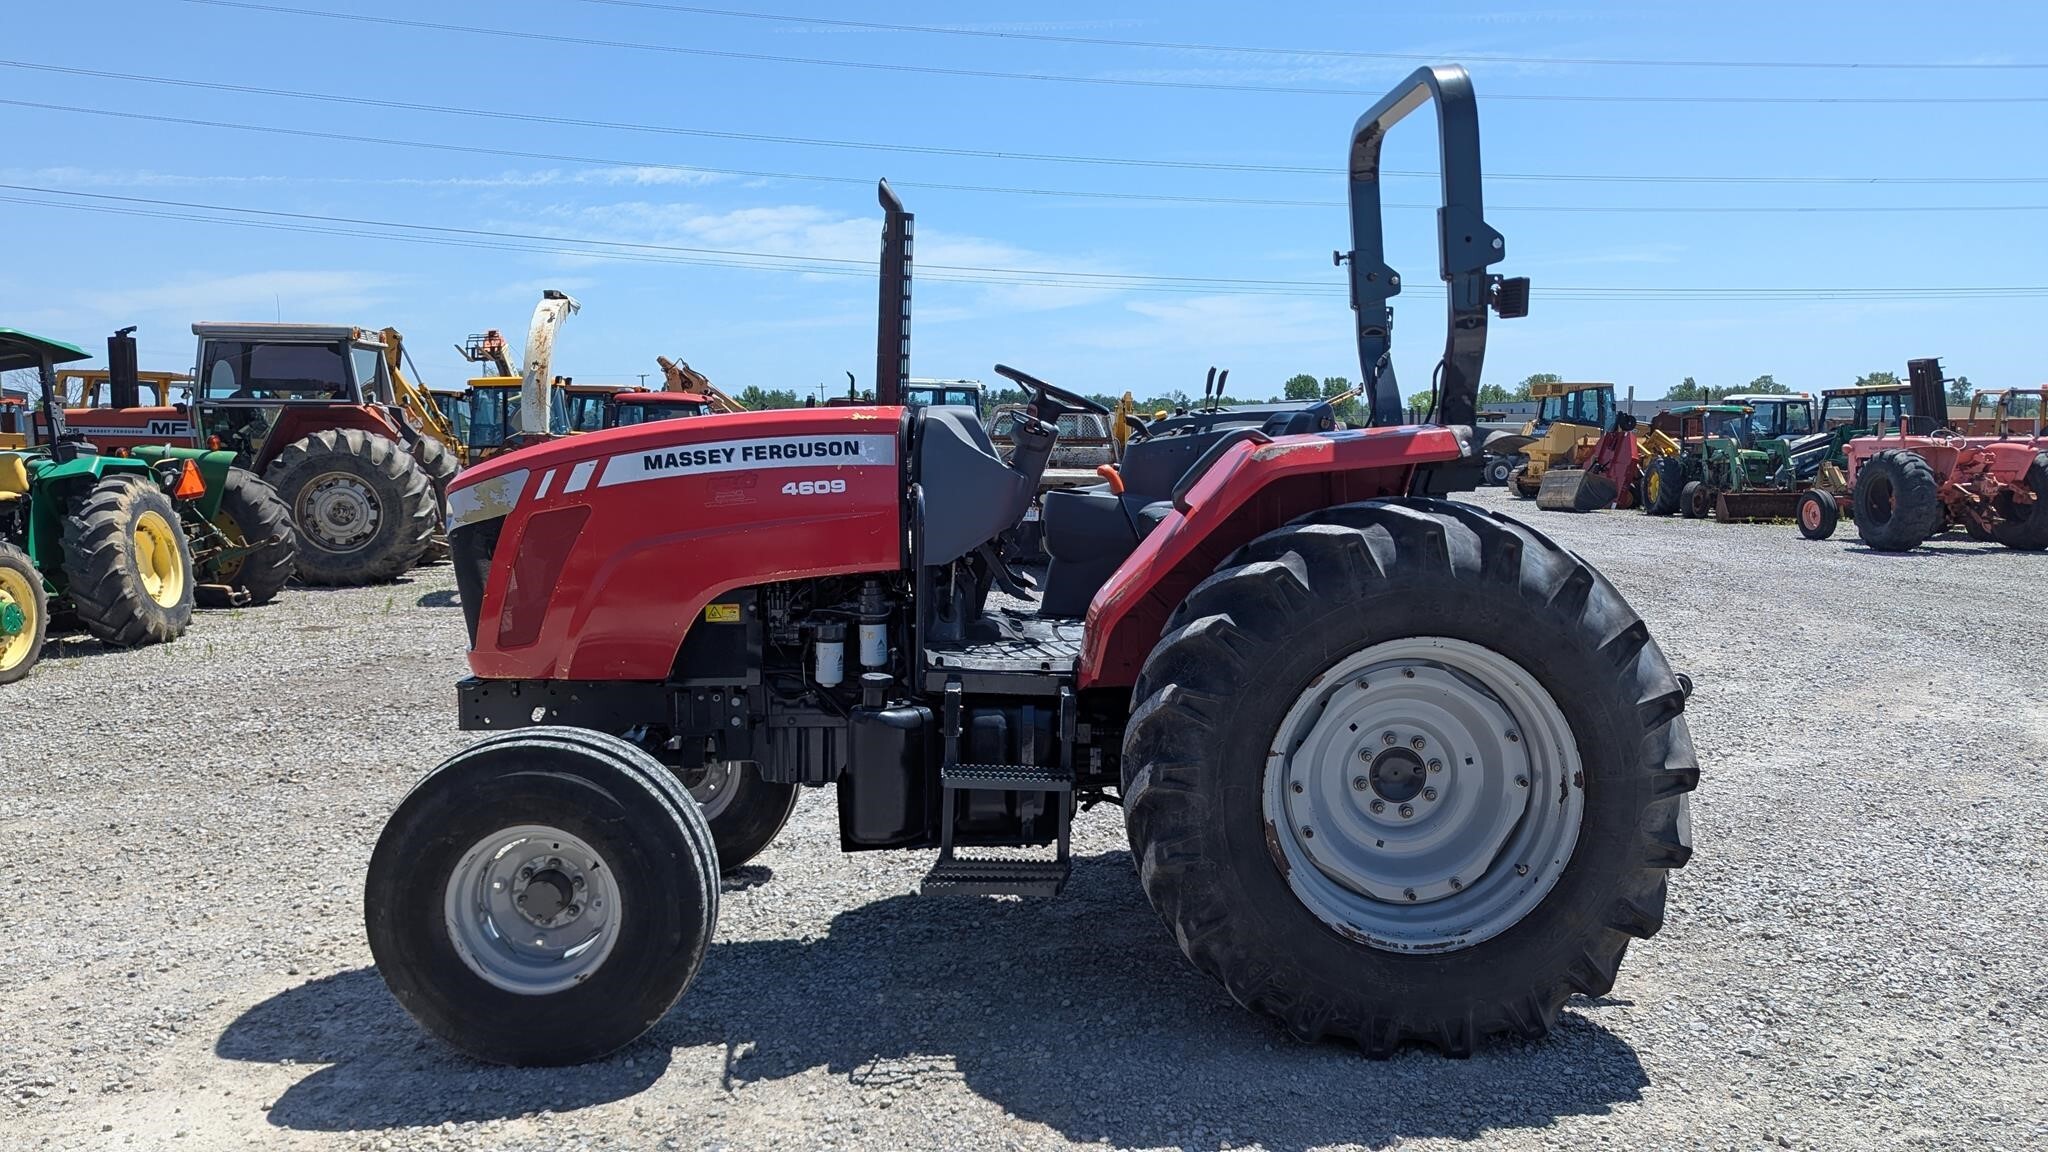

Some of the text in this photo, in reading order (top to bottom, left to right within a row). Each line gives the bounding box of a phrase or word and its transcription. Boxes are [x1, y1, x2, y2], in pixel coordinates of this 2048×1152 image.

[151, 422, 188, 435] MF
[643, 440, 860, 470] MASSEY FERGUSON
[781, 479, 846, 495] 4609
